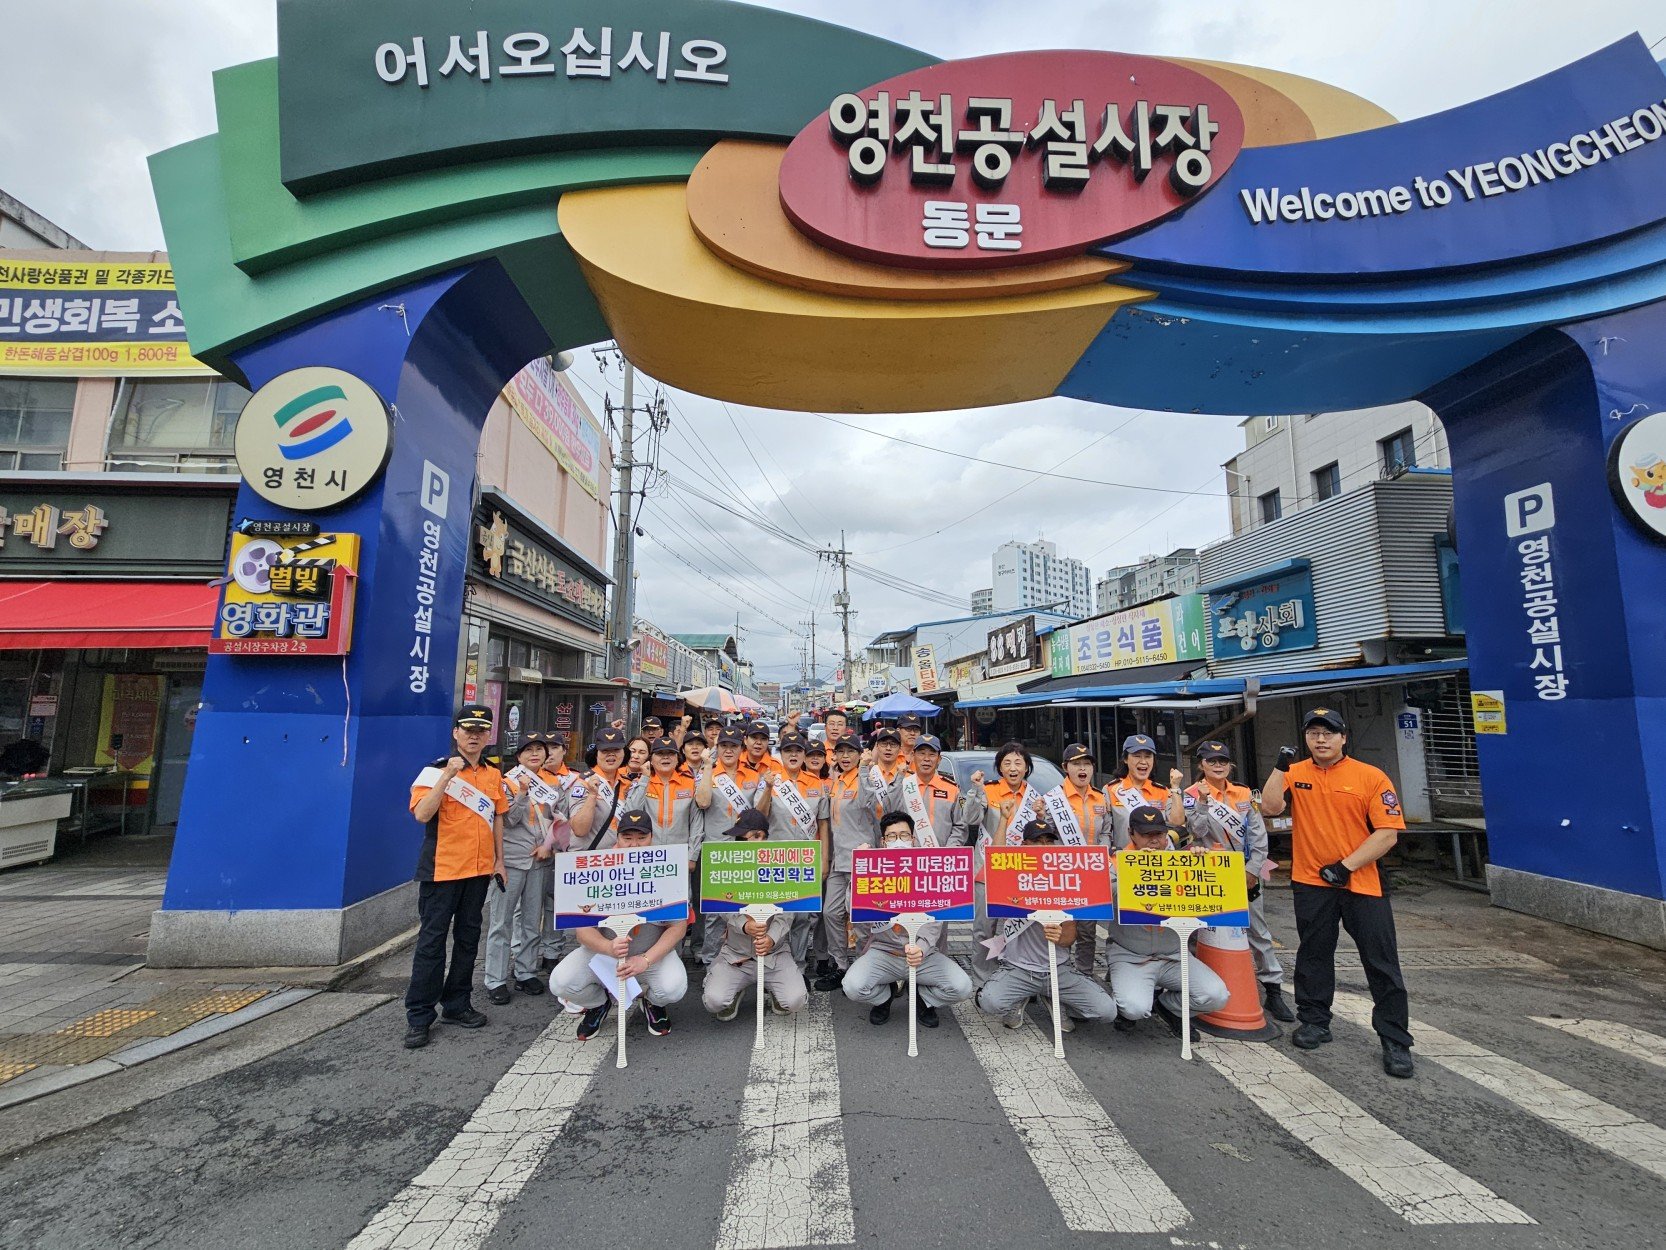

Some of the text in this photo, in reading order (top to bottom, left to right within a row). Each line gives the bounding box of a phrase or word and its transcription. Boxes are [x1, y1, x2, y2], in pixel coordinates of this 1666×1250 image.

[374, 26, 730, 88] 어서오십시오
[828, 90, 1219, 194] 영천공설시장
[1241, 185, 1412, 223] Welcome
[1414, 175, 1453, 208] to
[922, 200, 1024, 251] 동문
[0, 297, 140, 334] 민생회복
[5, 346, 178, 363] 한돈해동삼겹100g 1,800원
[263, 466, 347, 492] 영천시
[428, 470, 444, 506] P
[1517, 493, 1543, 529] P
[0, 504, 109, 549] 매장
[252, 521, 311, 533] 영천공설시장
[269, 565, 319, 593] 별빛
[409, 519, 441, 694] 영천공설시장
[221, 602, 330, 638] 영화관
[1217, 599, 1304, 650] 포항상회
[1517, 535, 1570, 701] 영천공설시장
[223, 641, 288, 652] 공설시장주차장
[1077, 617, 1163, 662] 조은식품
[1404, 720, 1413, 728] 51
[780, 784, 812, 825] 화재예방
[904, 781, 935, 847] 산불조심
[575, 849, 667, 869] 불조심!! 타협의
[709, 847, 816, 865] 한사람의 화재예방
[855, 855, 970, 875] 불나는 곳 따로없고
[990, 852, 1105, 871] 화재는 인정사정
[1125, 854, 1231, 868] 우리집 소화기 1개
[563, 863, 678, 885] 대상이 아닌 실천의
[709, 866, 816, 884] 천만인의 안전확보
[1017, 873, 1082, 892] 없습니다
[1140, 869, 1217, 883] 경보기 1개는
[587, 881, 657, 899] 대상입니다.
[856, 875, 968, 895] 불조심에 너나없다
[1133, 884, 1226, 898] 생명을 9합니다.
[597, 898, 663, 912] 남부119 의용소방대
[738, 891, 799, 900] 남부119 의용소방대
[889, 899, 951, 908] 남부119 의용소방대
[1024, 897, 1088, 906] 남부119 의용소방대
[1158, 903, 1223, 913] 남부119 의용소방대
